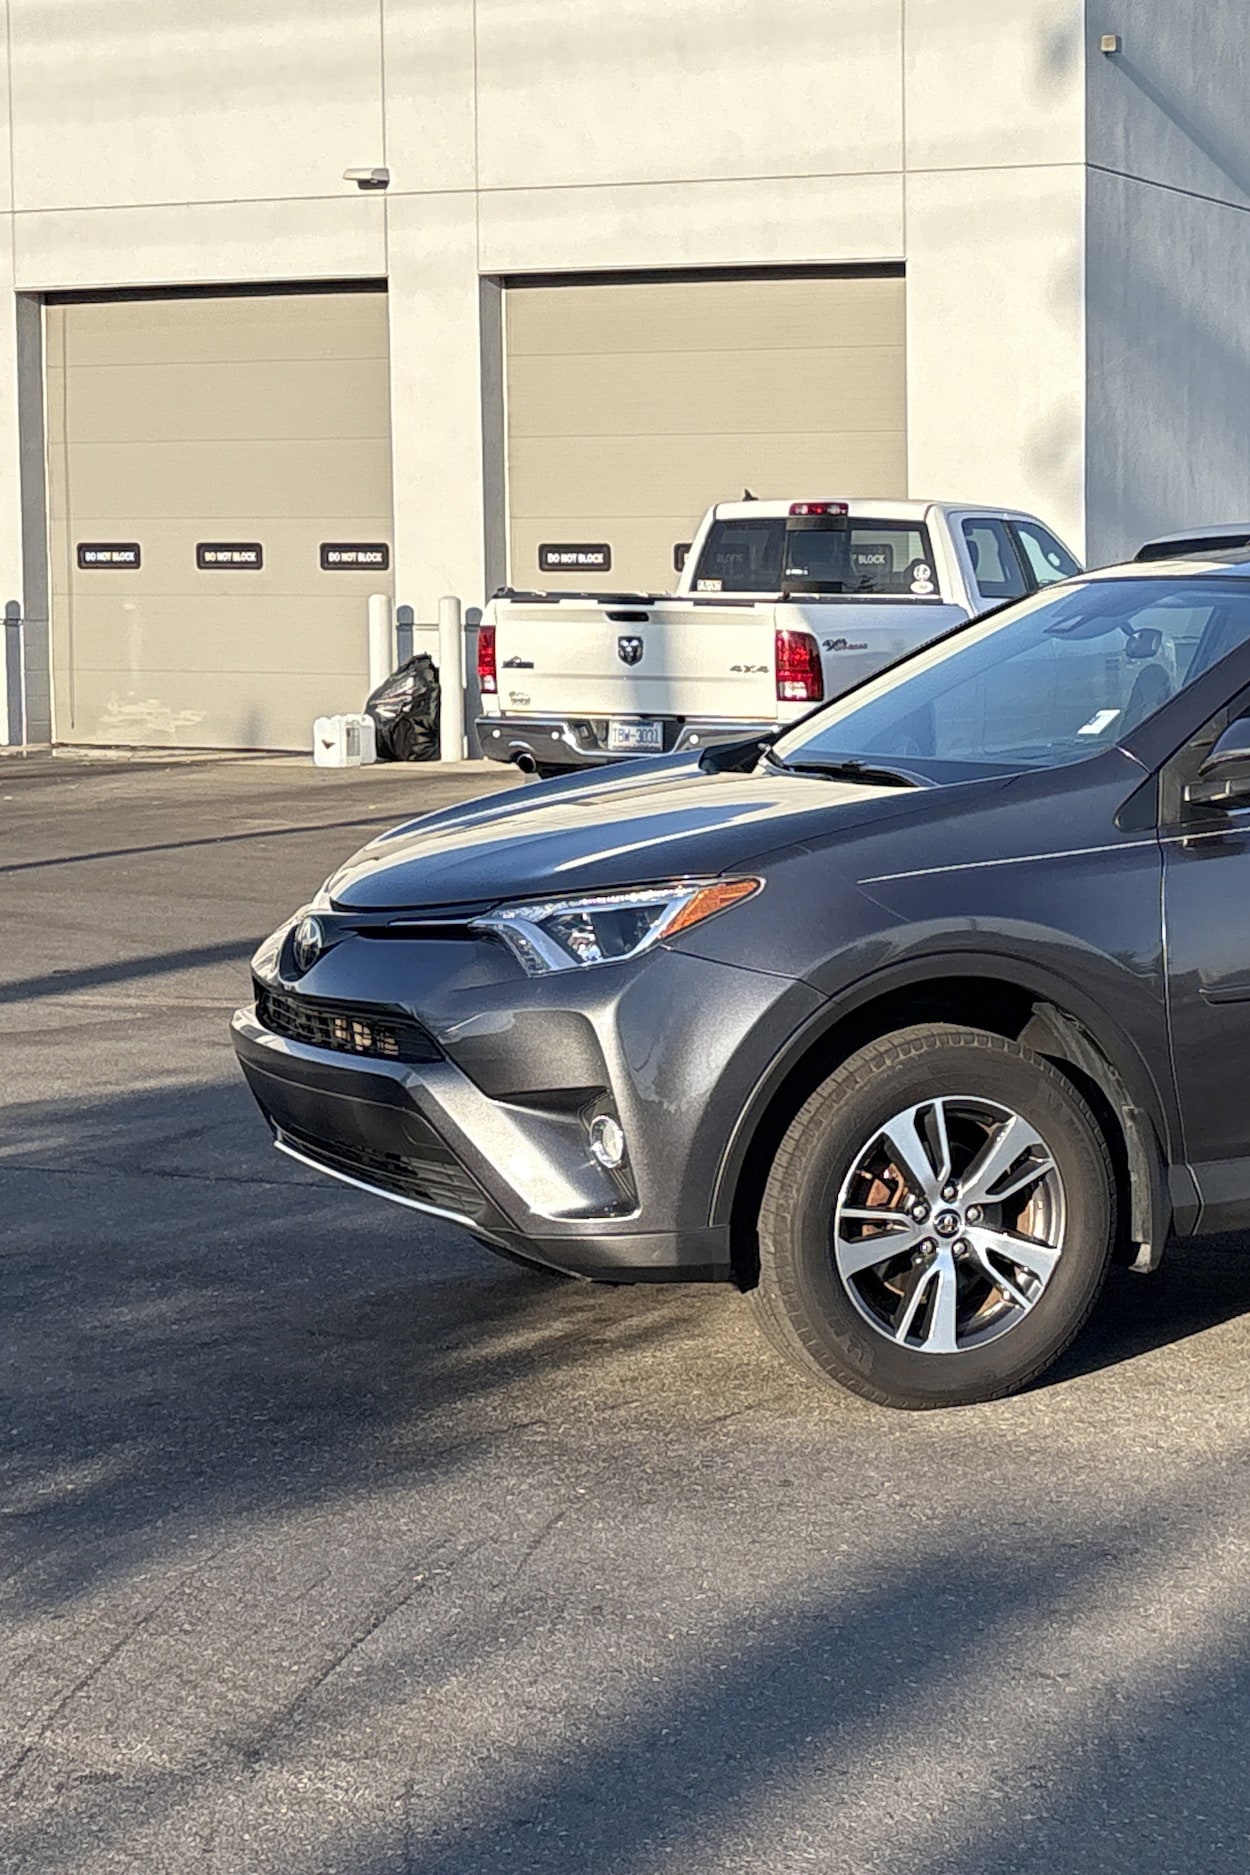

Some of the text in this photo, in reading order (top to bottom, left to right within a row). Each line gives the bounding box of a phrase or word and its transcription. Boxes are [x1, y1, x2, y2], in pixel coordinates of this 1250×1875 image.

[328, 551, 383, 562] DO NOT BLOCK
[547, 552, 604, 563] DO NOT BLOCK
[858, 553, 886, 564] BLOCK
